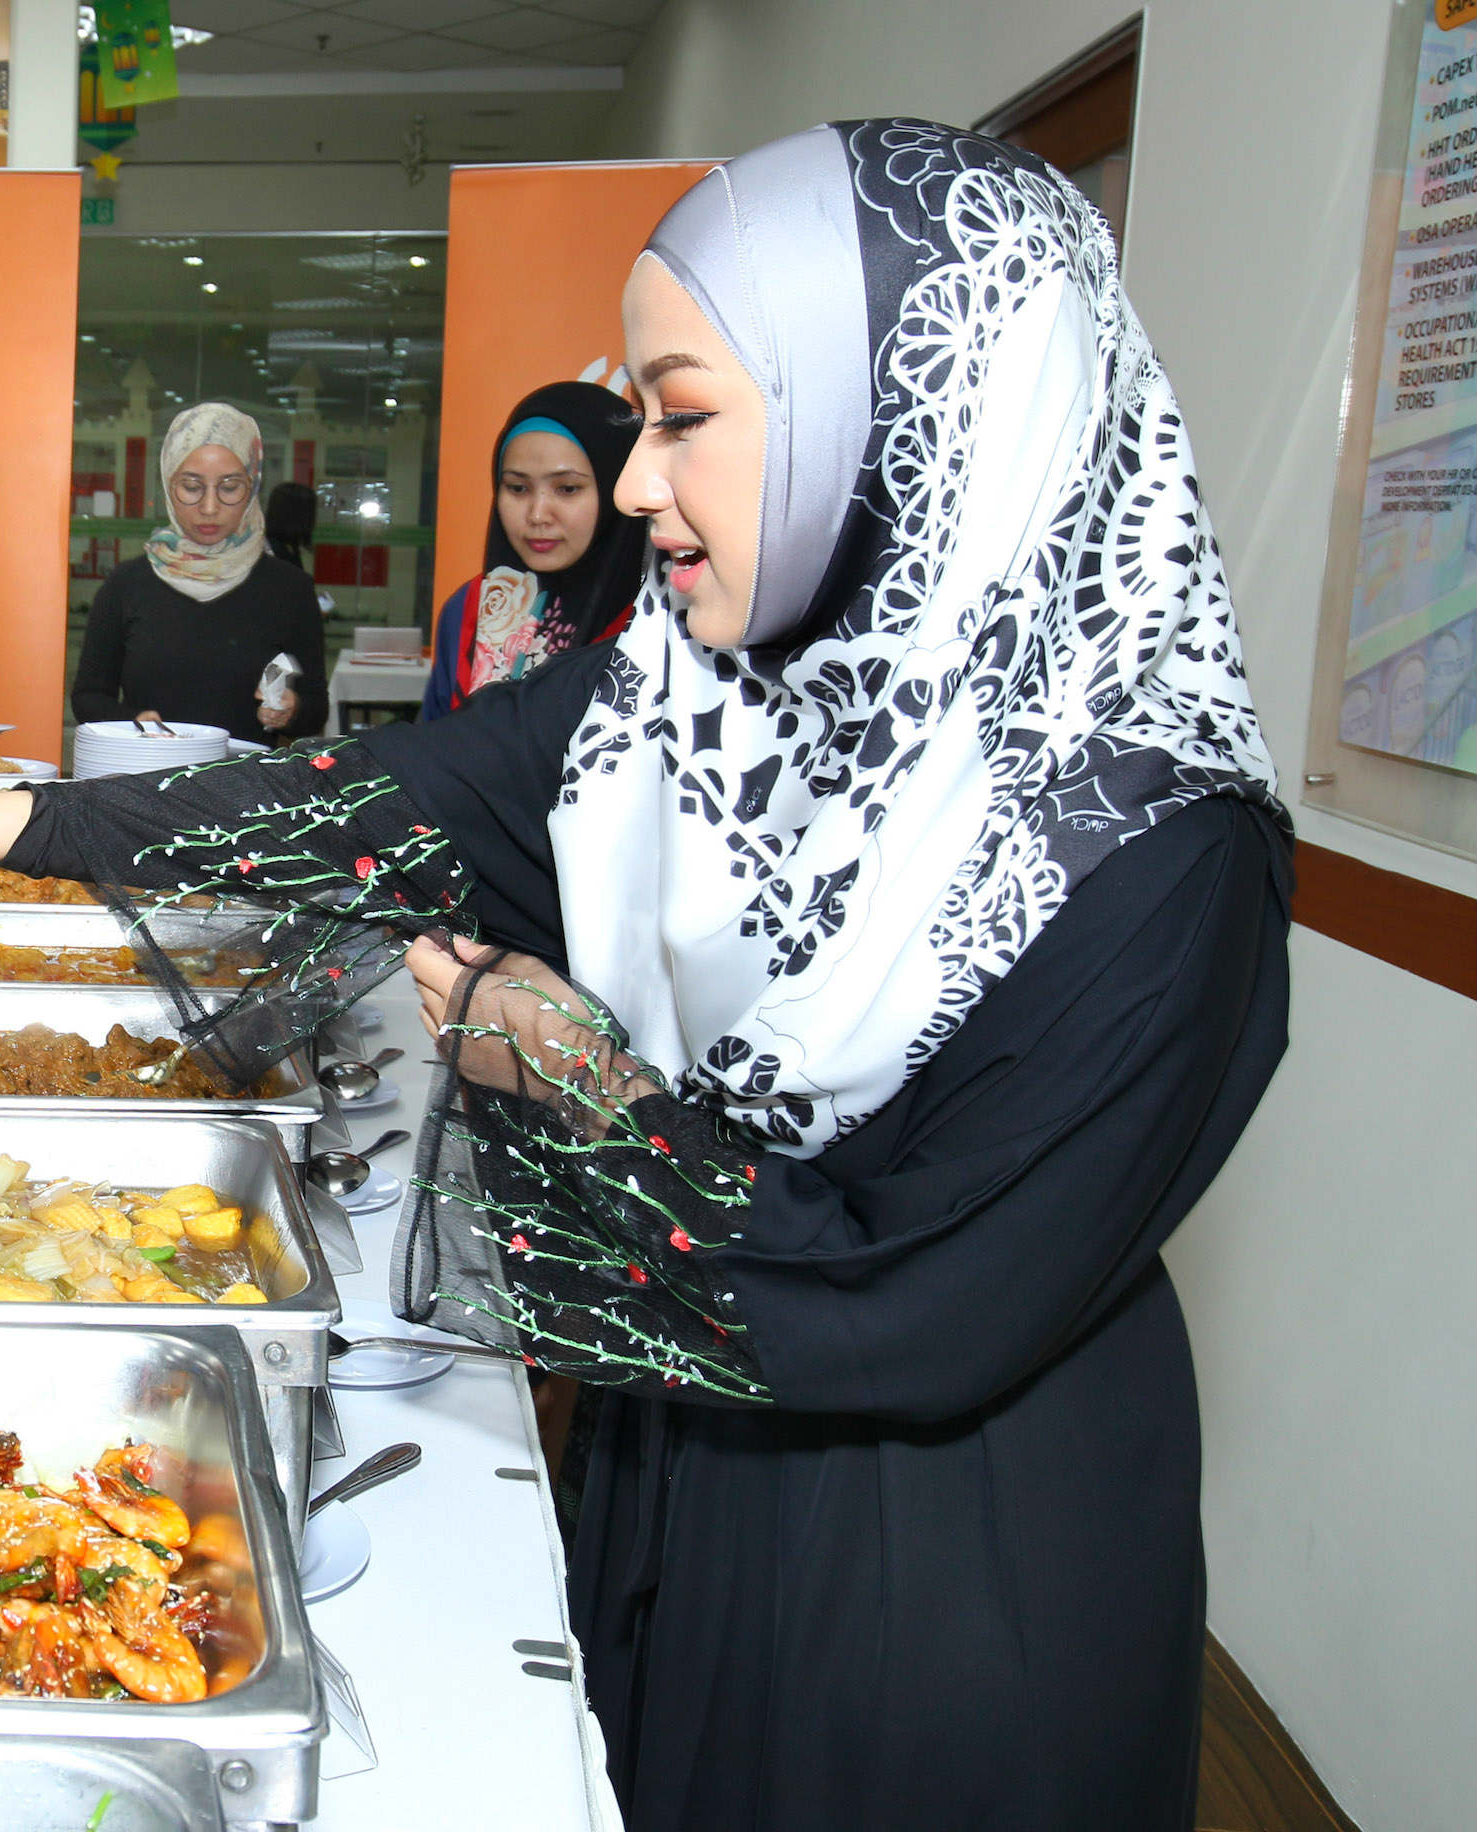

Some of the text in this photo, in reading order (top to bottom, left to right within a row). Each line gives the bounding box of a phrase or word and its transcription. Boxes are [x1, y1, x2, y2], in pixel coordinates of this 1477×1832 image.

[1437, 54, 1475, 86] CAPEX
[1427, 135, 1452, 159] HHT
[1409, 277, 1459, 304] SYSTEMS
[1401, 341, 1444, 363] HEALTH
[1444, 338, 1468, 358] ACT
[1395, 390, 1436, 411] STORES
